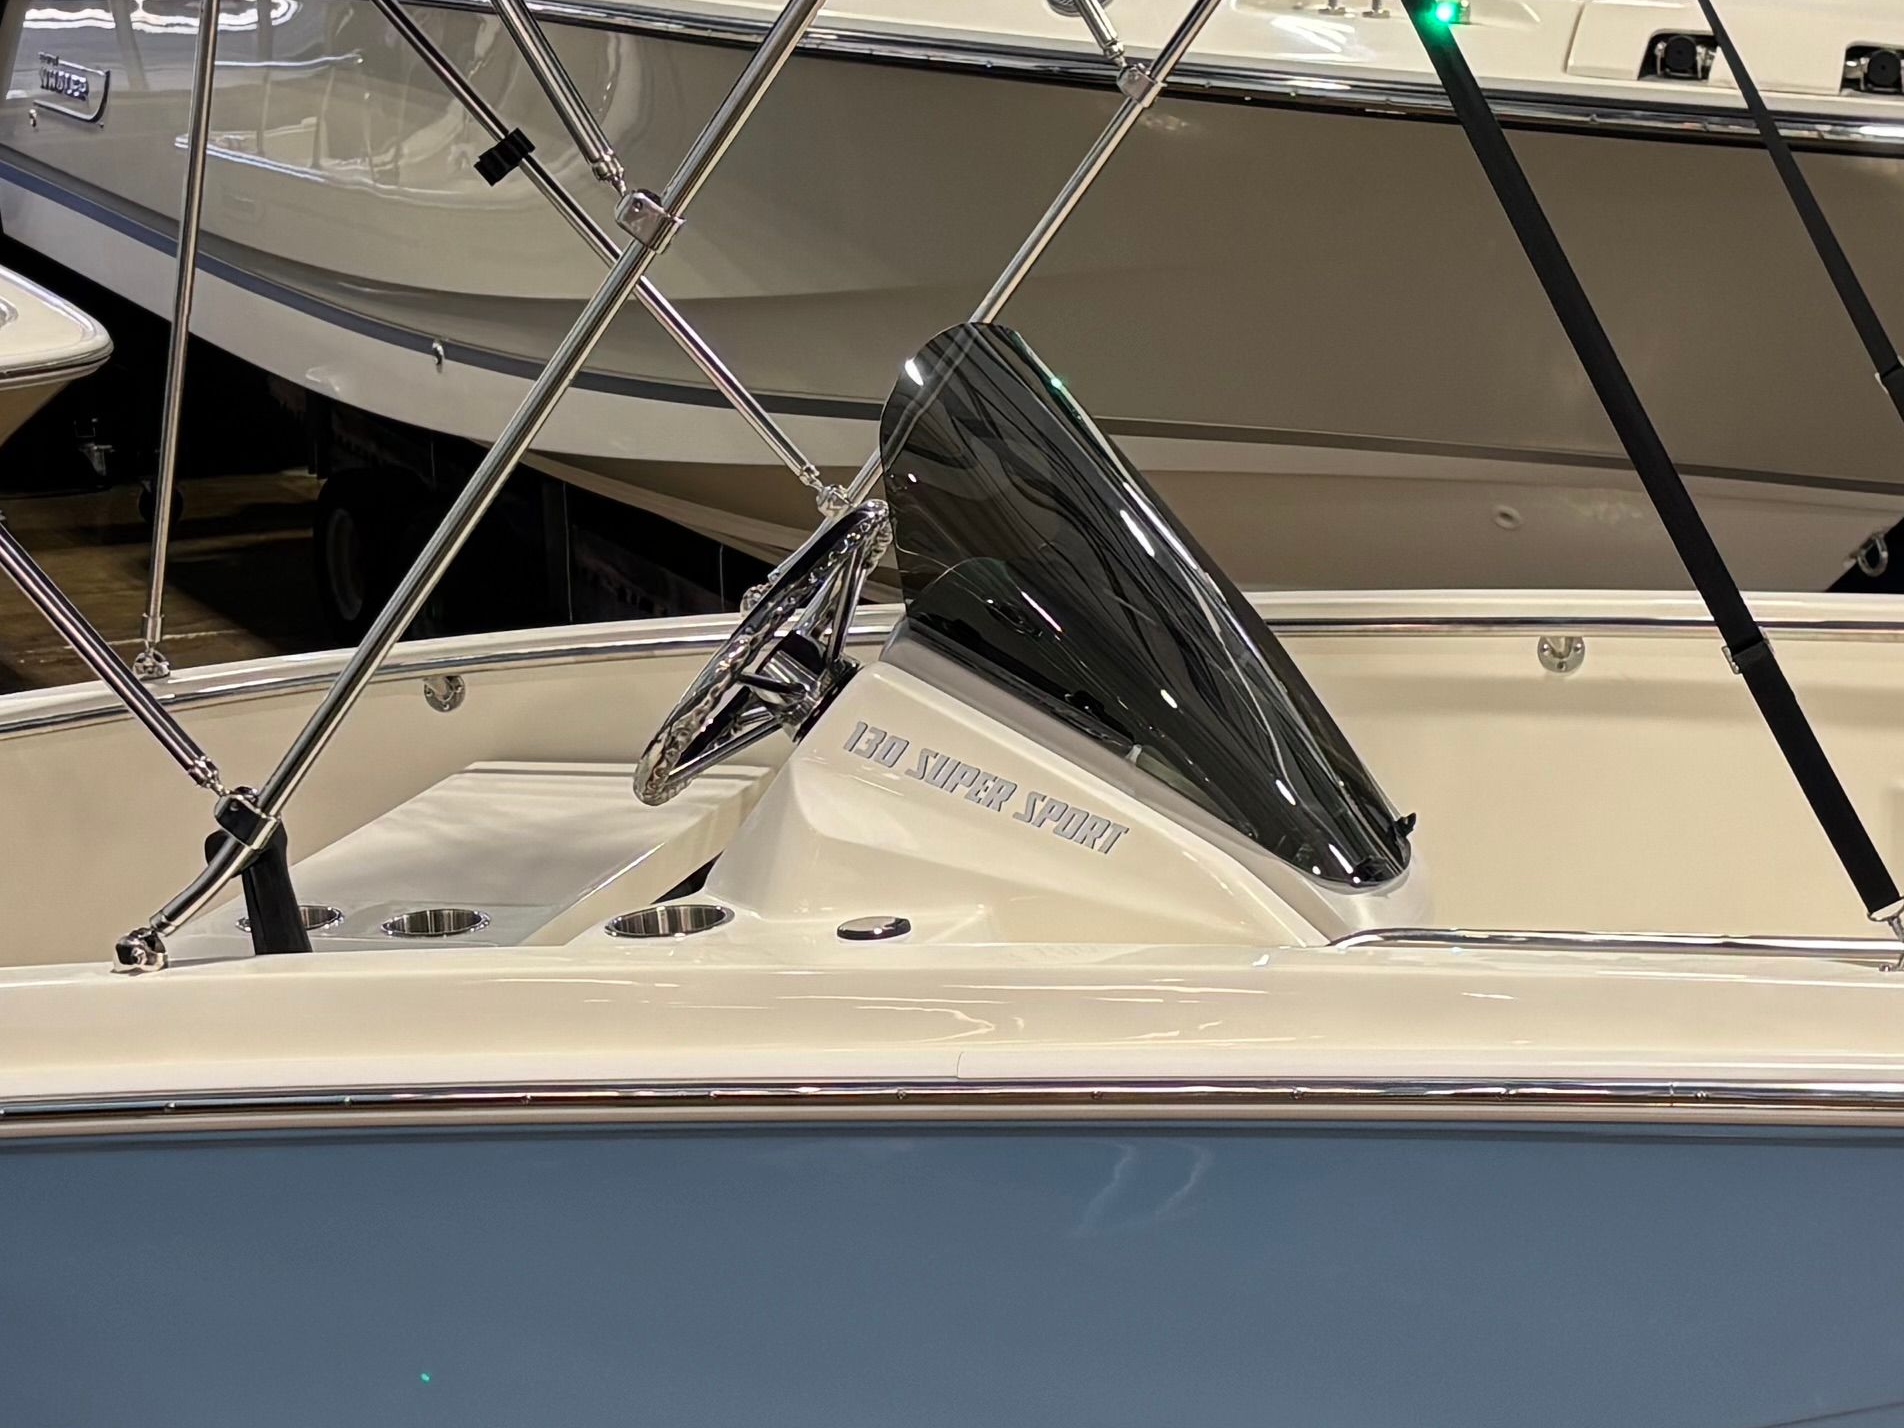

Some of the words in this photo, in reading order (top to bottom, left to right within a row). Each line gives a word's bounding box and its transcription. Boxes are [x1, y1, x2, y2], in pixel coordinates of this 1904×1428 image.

[842, 721, 909, 768] 130
[904, 747, 1017, 812] SUPER
[1012, 791, 1130, 854] SPORT
